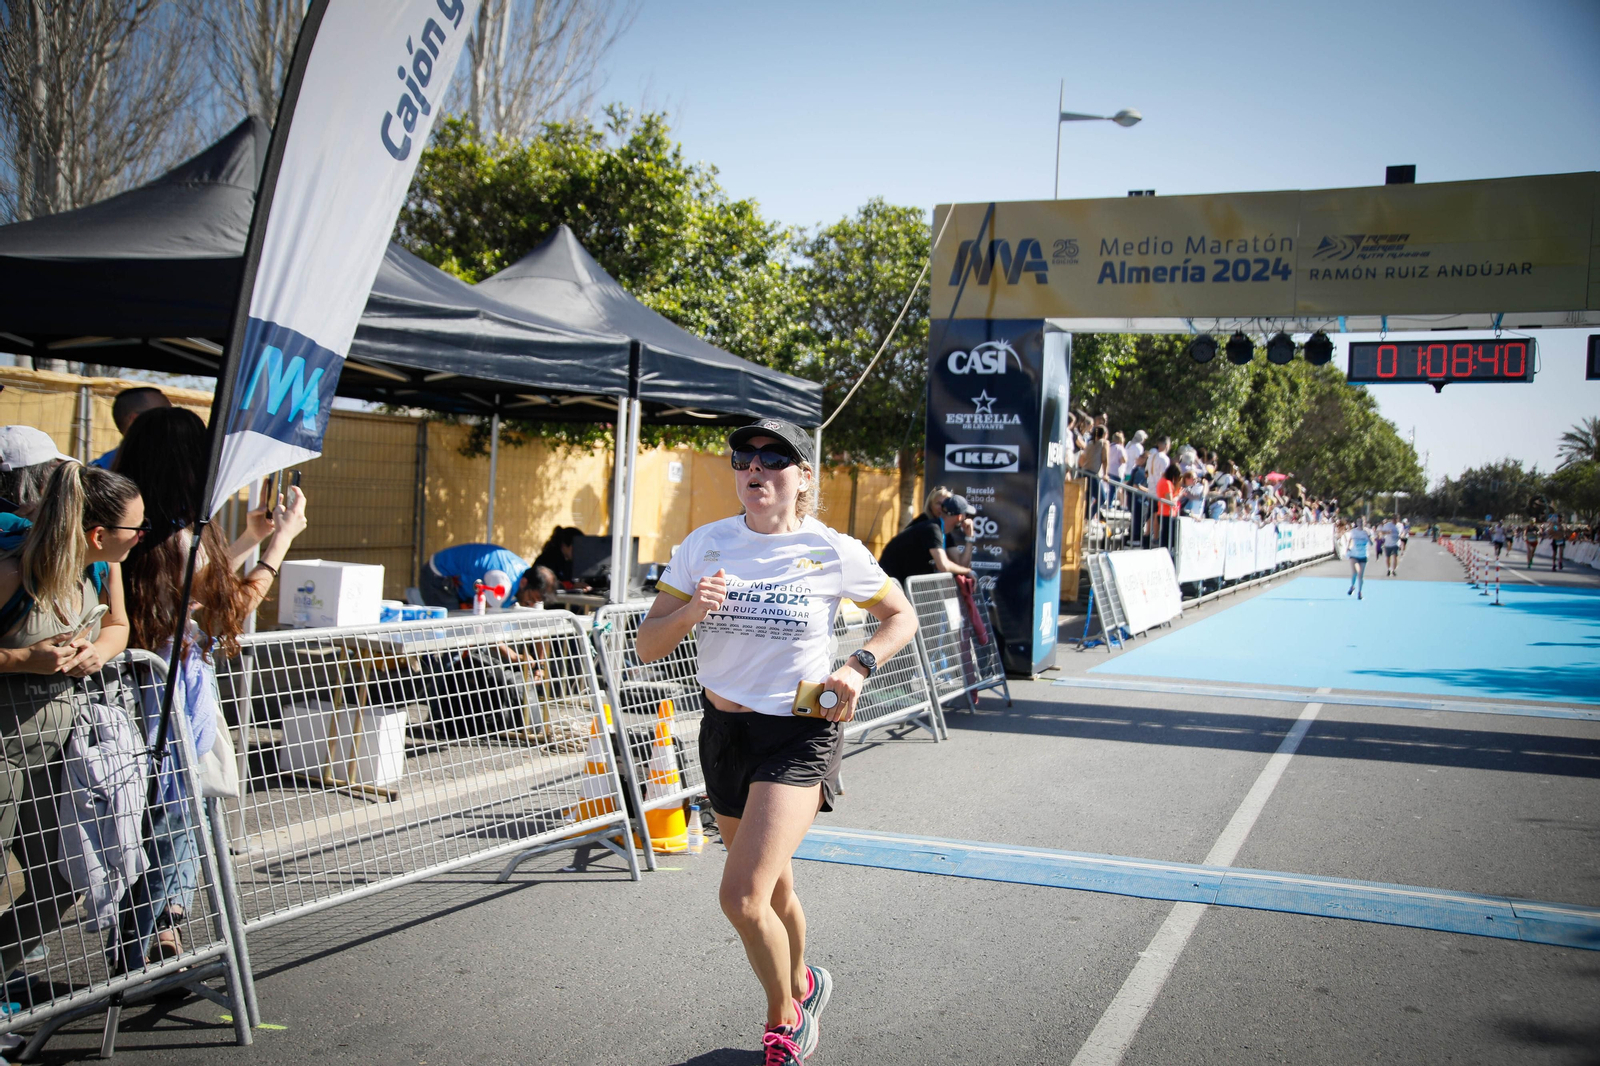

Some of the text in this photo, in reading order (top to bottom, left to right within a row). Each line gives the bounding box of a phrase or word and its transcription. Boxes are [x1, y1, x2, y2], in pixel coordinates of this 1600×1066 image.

[381, 17, 446, 161] Cajón
[1053, 239, 1079, 258] 25
[1099, 233, 1293, 256] Medio Maratón
[1097, 257, 1292, 284] Almería 2024
[1309, 260, 1532, 280] RAMÓN RUIZ ANDÚJAR
[947, 350, 1006, 375] CASI
[945, 413, 1021, 424] ESTRELLA
[955, 452, 1010, 464] IKEA
[966, 486, 995, 495] Barceló
[985, 495, 996, 503] de
[750, 581, 812, 594] Maratón
[764, 592, 809, 606] 2024
[733, 605, 757, 615] RUIZ
[761, 607, 809, 619] ANDÚJAR
